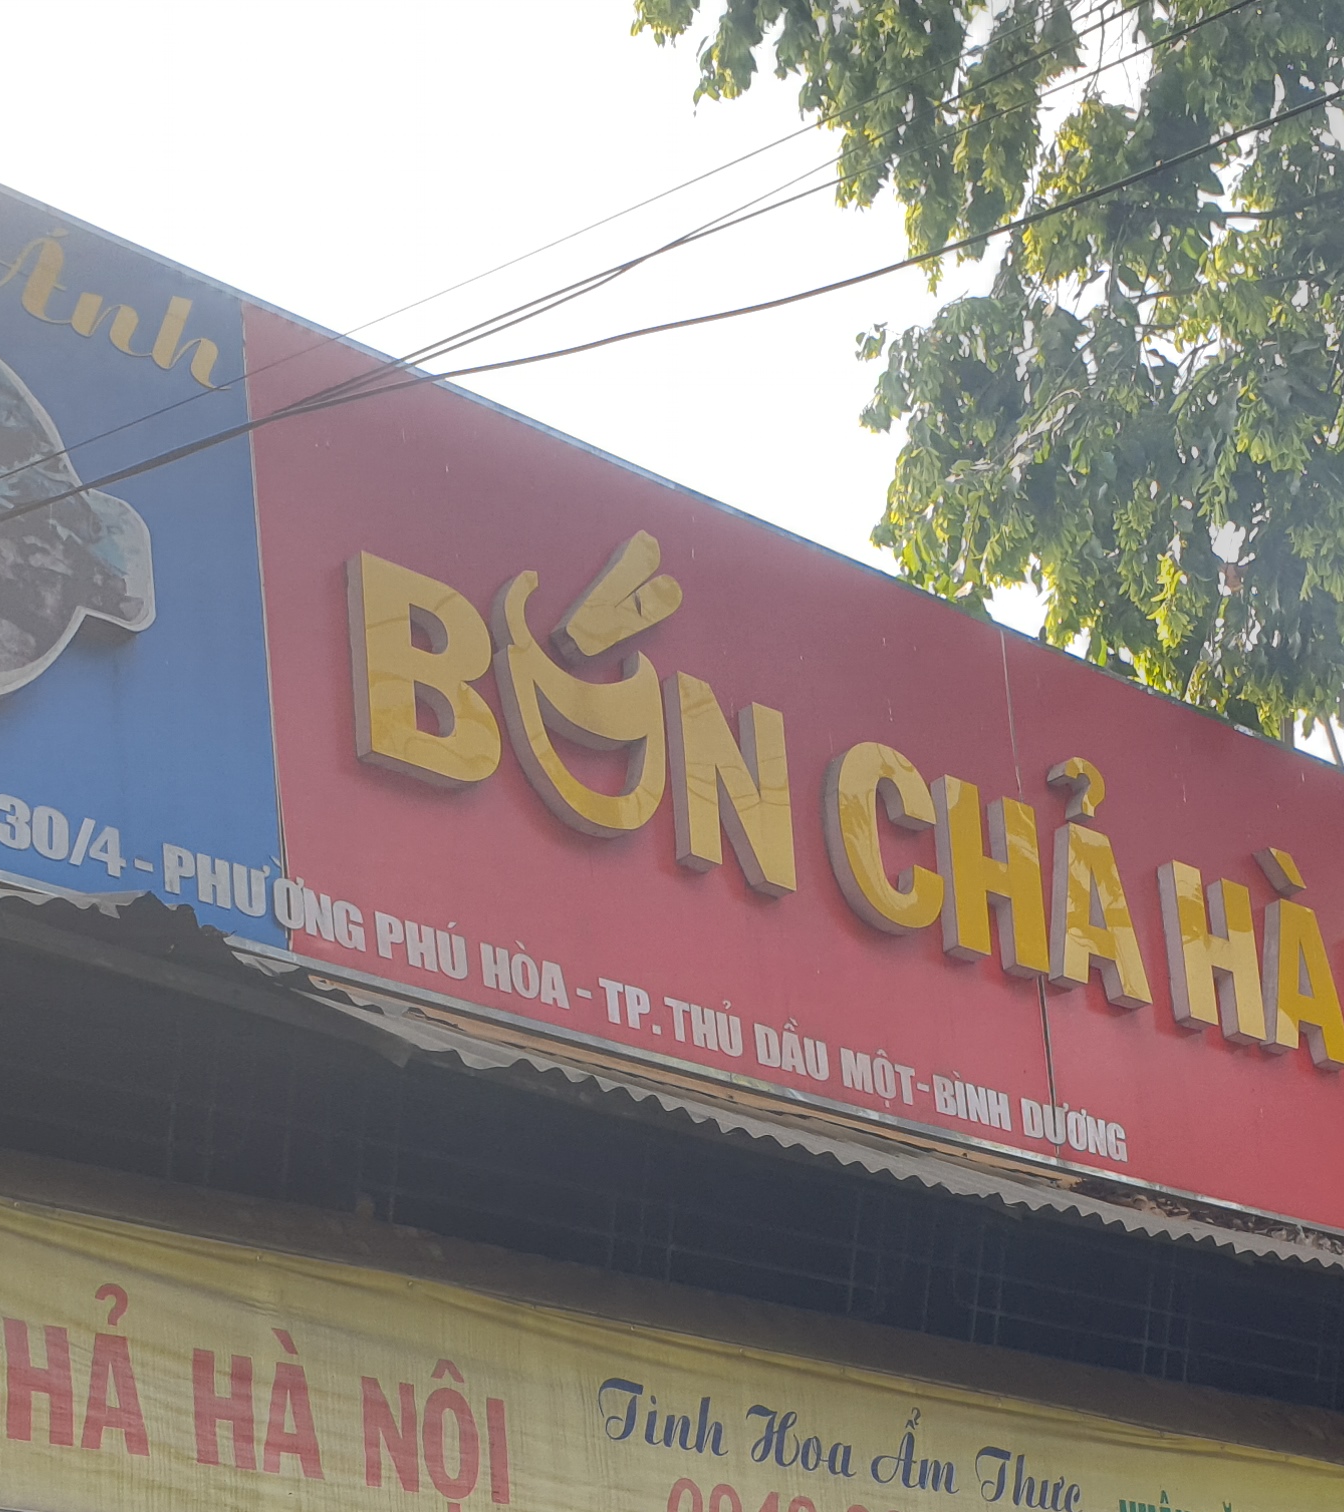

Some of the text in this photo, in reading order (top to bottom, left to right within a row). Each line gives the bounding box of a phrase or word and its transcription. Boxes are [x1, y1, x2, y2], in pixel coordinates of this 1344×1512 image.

[822, 757, 1153, 1010] CHẢ
[162, 843, 367, 952] PHƯỜNG
[374, 922, 469, 980] PHÚ
[479, 940, 570, 1009] HÒA
[754, 1017, 830, 1081] DẦU
[1021, 1097, 1129, 1162] DƯƠNG
[191, 1328, 326, 1481] HÀ
[598, 1378, 729, 1457] Tinh
[745, 1404, 857, 1478] Hoa
[871, 1407, 960, 1495] Ẩm
